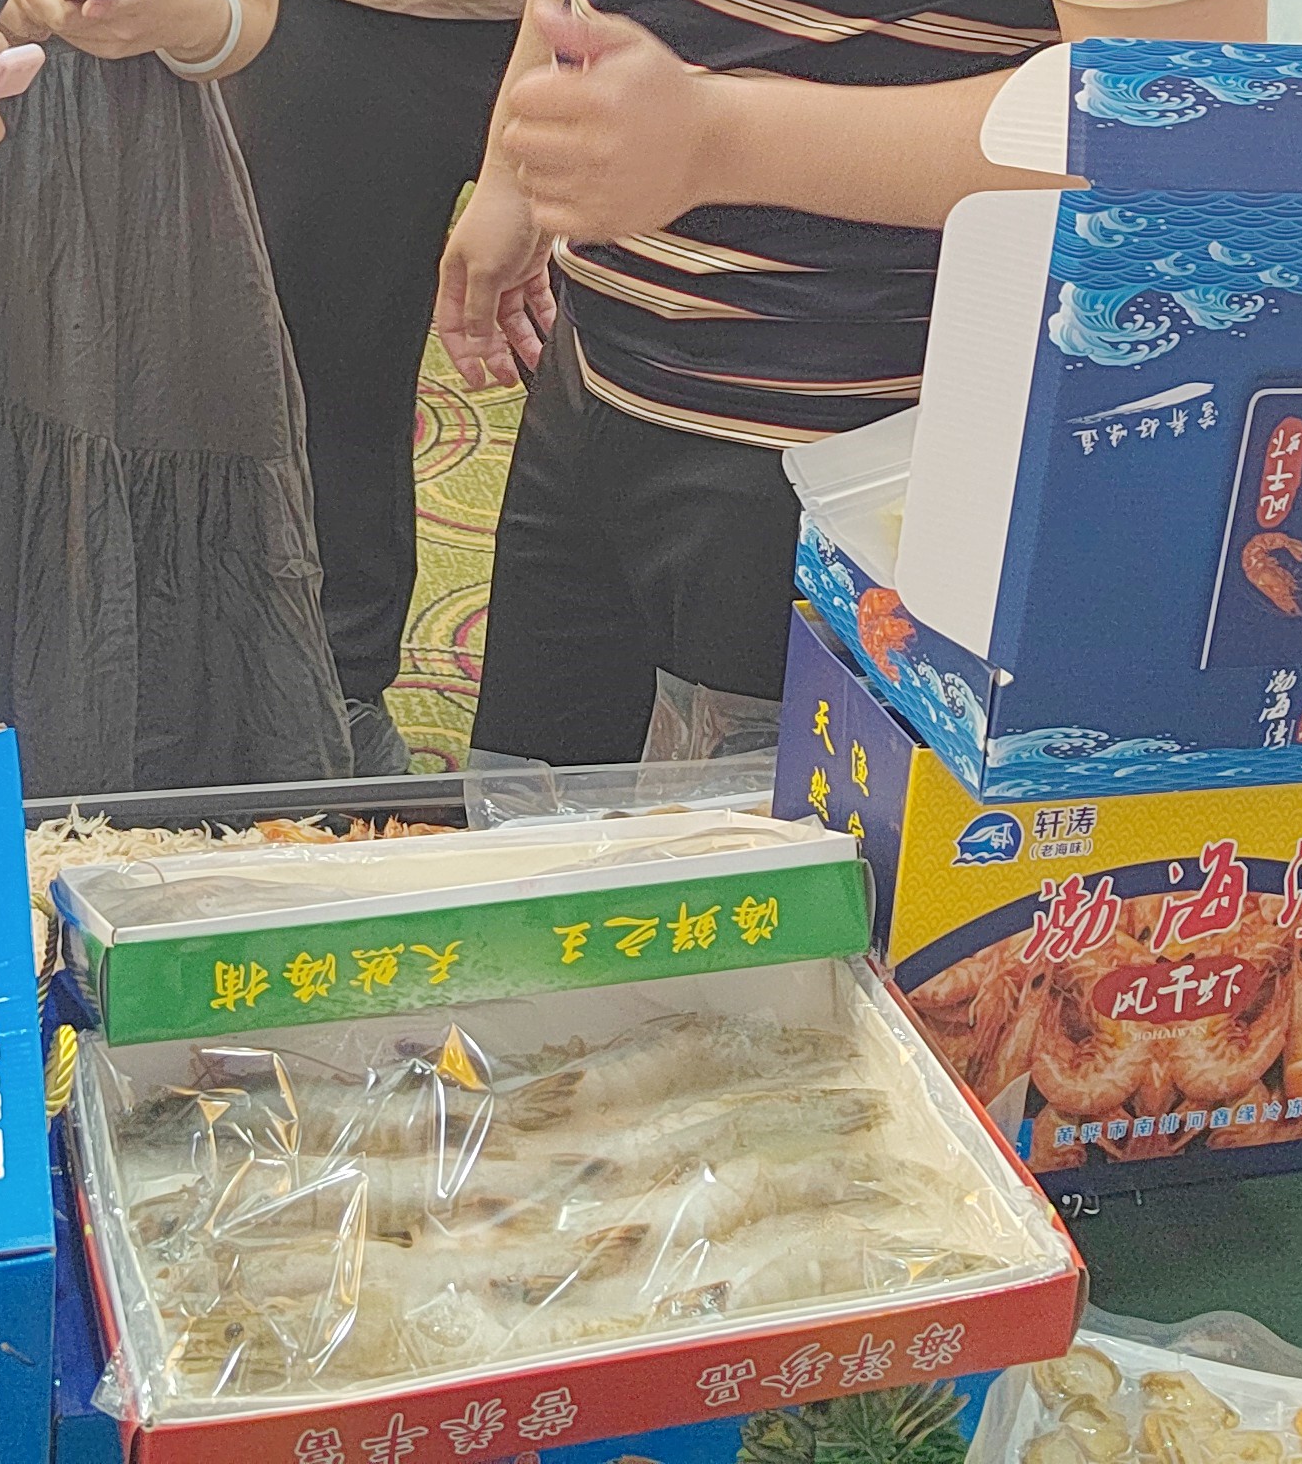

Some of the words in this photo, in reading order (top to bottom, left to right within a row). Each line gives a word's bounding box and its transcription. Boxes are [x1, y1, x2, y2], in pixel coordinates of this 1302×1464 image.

[1072, 400, 1220, 456] 营养好味道
[1259, 428, 1302, 521] 风干虾
[1034, 806, 1096, 838] 轩涛
[554, 894, 781, 965] 海鲜之王
[209, 940, 462, 1012] 天然海捕
[1110, 963, 1244, 1017] 风干虾
[696, 1320, 969, 1409] 海洋珍品
[293, 1386, 581, 1464] 营养丰富
